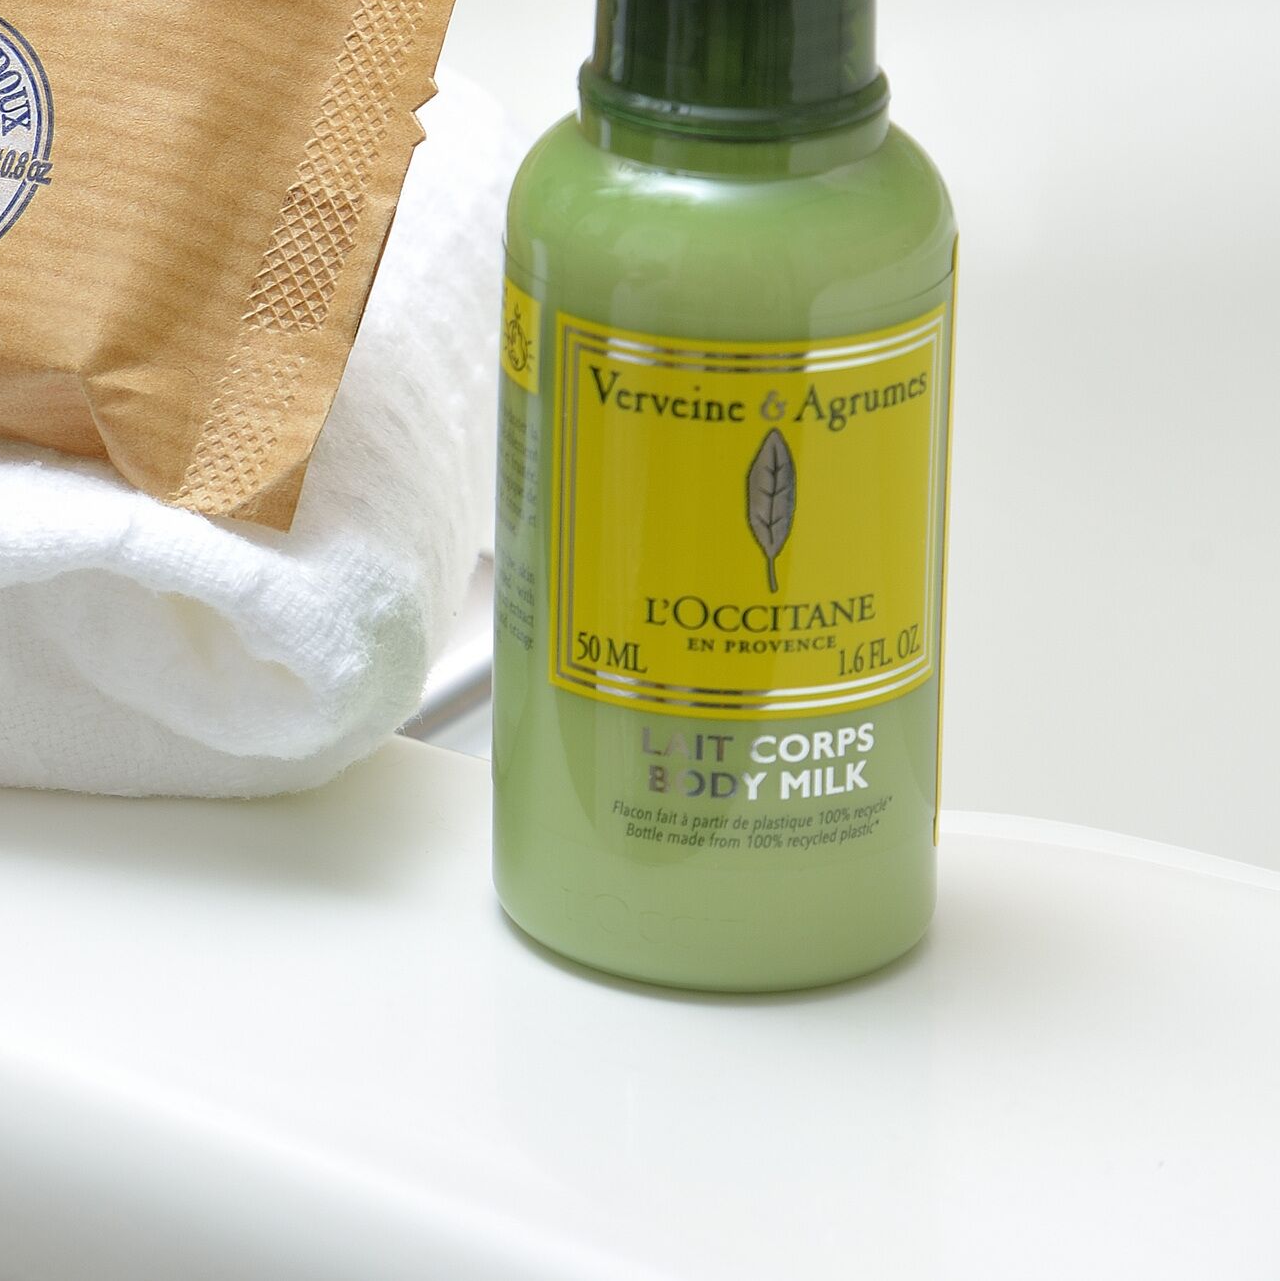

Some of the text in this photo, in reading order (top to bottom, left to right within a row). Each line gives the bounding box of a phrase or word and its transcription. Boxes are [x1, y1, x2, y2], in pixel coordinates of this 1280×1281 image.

[27, 160, 53, 185] oz
[589, 366, 928, 432] Verveine & Agrumes
[644, 594, 876, 633] L'OCCITANE
[576, 631, 649, 674] 50 ML
[687, 635, 837, 653] EN PROVENCE
[838, 649, 865, 676] 1.6
[869, 638, 893, 671] FL.
[642, 722, 875, 764] LAIT CORPS
[648, 760, 869, 801] BODY MILK
[612, 800, 652, 821] Flacon
[655, 808, 677, 825] fait
[680, 812, 688, 827] à
[692, 815, 729, 832] partir
[732, 816, 749, 830] de
[753, 815, 813, 834] plastique
[819, 807, 850, 825] 100%
[626, 823, 663, 842] Bottle
[667, 832, 705, 847] made
[709, 832, 740, 849] from
[748, 834, 783, 849] 100%
[787, 828, 838, 850] recycled
